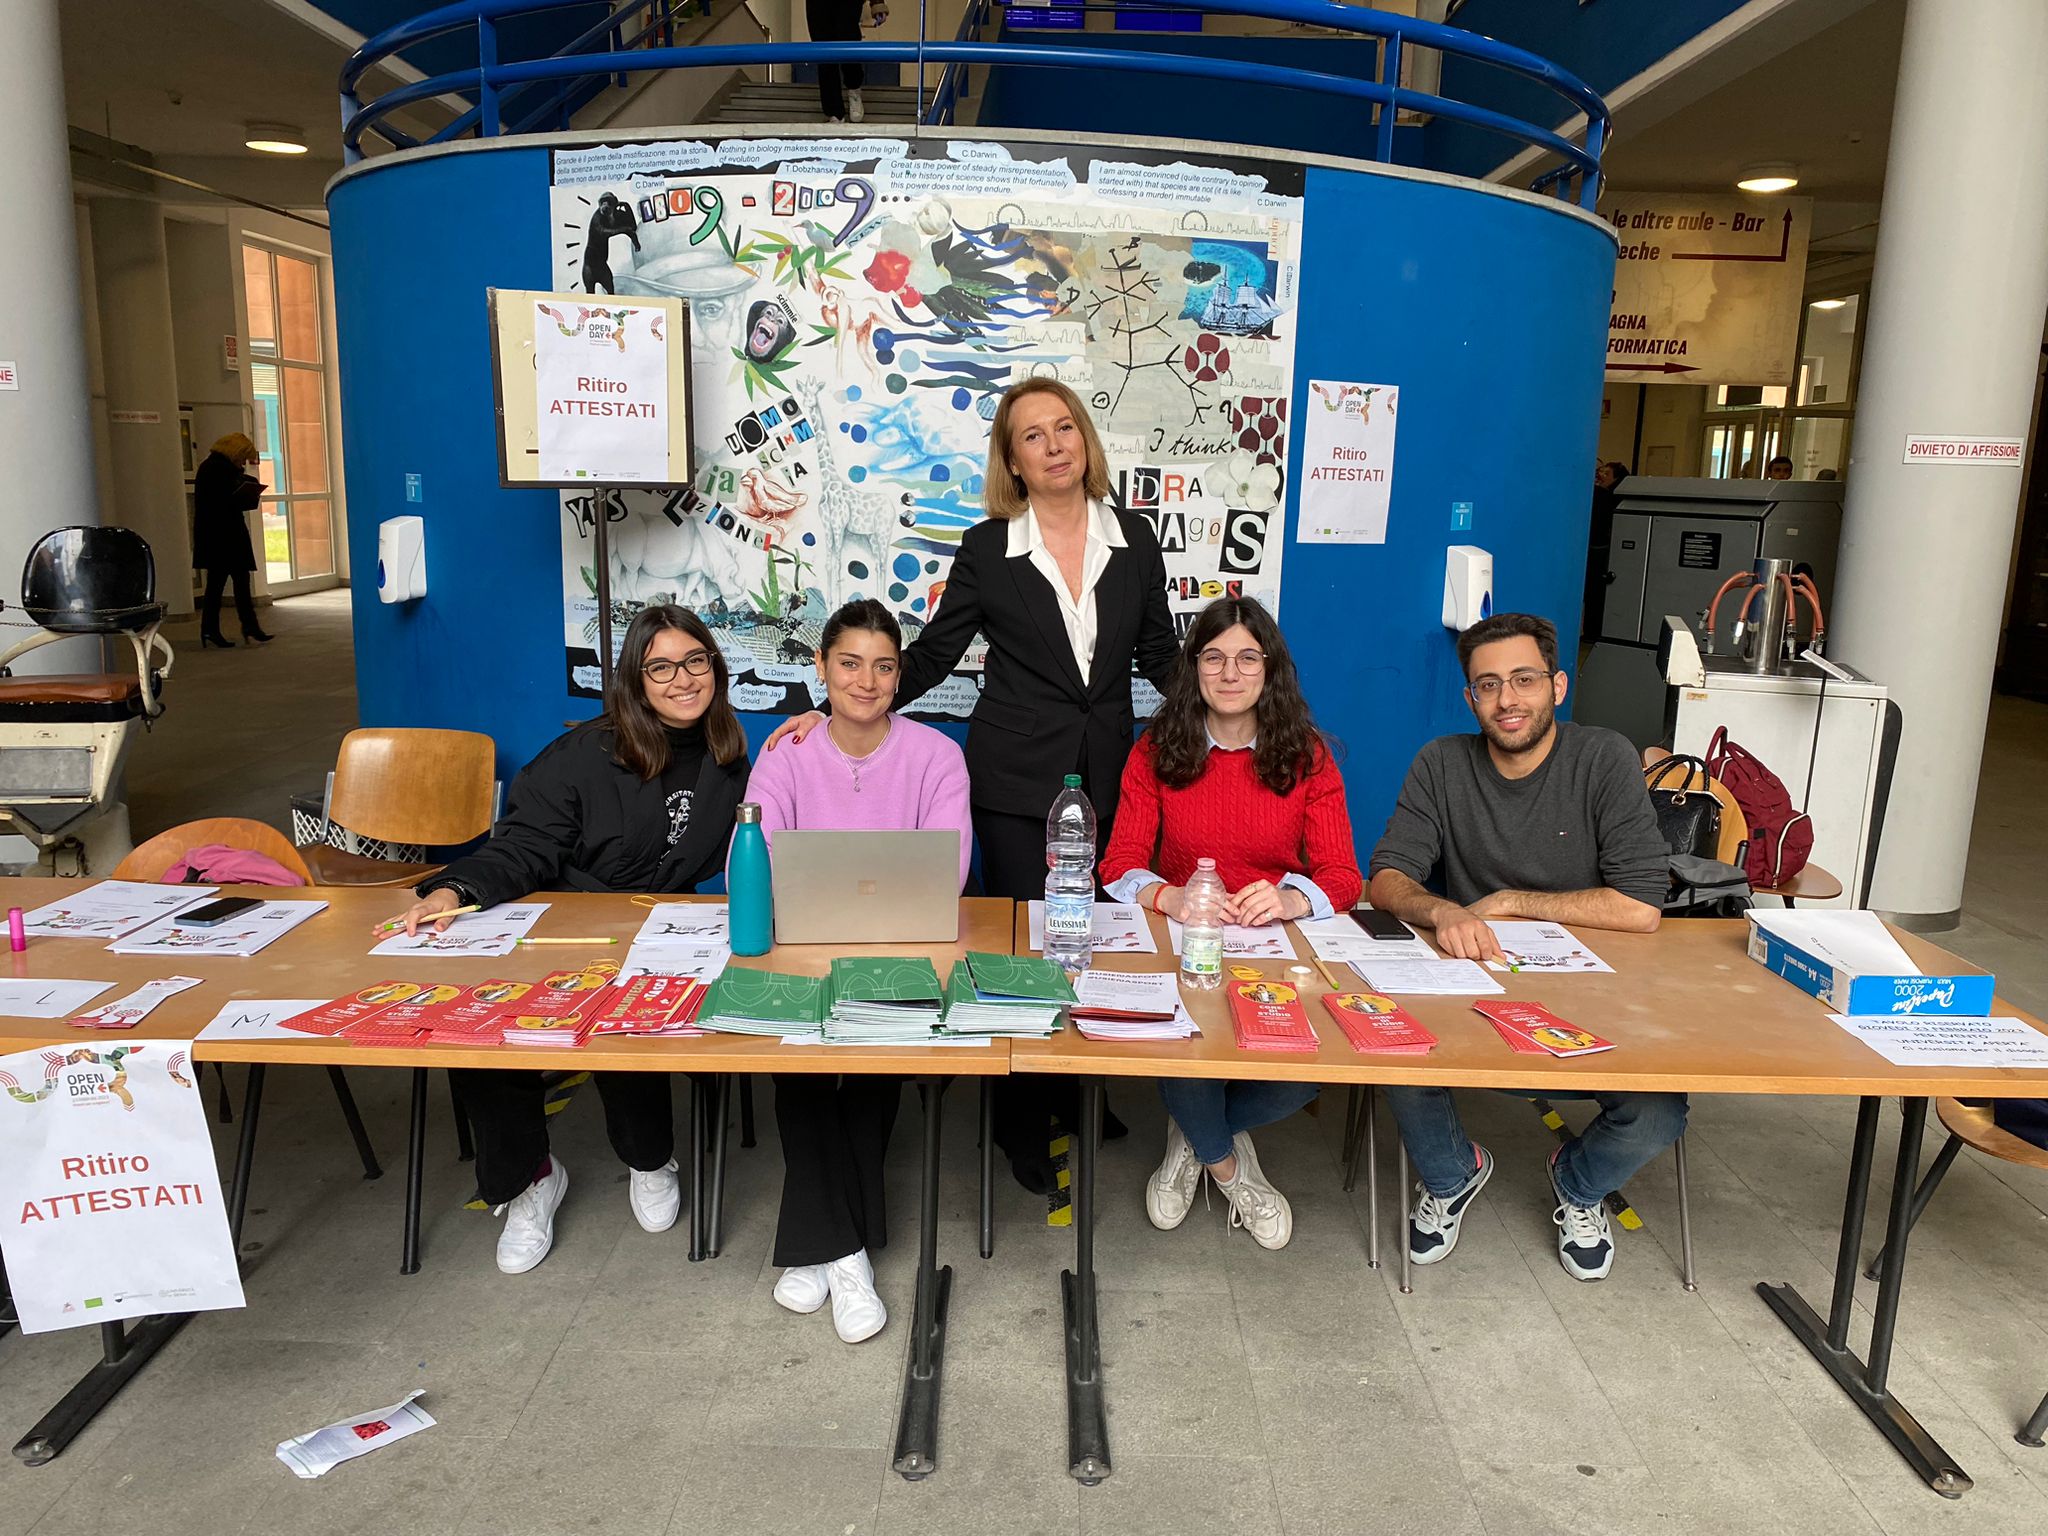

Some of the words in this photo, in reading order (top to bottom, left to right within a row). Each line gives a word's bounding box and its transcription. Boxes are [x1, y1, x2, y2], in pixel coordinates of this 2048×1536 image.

[556, 158, 576, 166] Grande
[587, 155, 606, 164] potere
[607, 153, 622, 161] della
[689, 147, 708, 155] storia
[718, 145, 747, 155] Nothing
[748, 145, 754, 153] in
[756, 145, 783, 154] biology
[784, 145, 809, 153] makes
[834, 145, 860, 155] except
[861, 145, 868, 153] in
[869, 145, 882, 154] the
[883, 145, 900, 156] light
[961, 149, 998, 160] C.Darwin
[556, 167, 570, 175] della
[571, 165, 593, 174] scienza
[594, 164, 614, 172] mostra
[615, 162, 627, 170] che
[628, 158, 676, 169] fortunatamente
[678, 158, 700, 167] questo
[728, 155, 760, 163] evolution
[890, 160, 913, 169] Great
[914, 161, 921, 169] is
[922, 162, 935, 170] the
[936, 163, 961, 173] power
[962, 163, 971, 171] of
[971, 164, 997, 174] steady
[998, 166, 1068, 178] misrepresentation,
[556, 177, 575, 185] potere
[576, 175, 587, 183] non
[588, 174, 601, 182] dura
[607, 173, 625, 182] lungo
[890, 171, 903, 179] but
[904, 171, 917, 179] the
[918, 172, 945, 182] history
[946, 172, 955, 181] of
[955, 174, 985, 183] science
[986, 175, 1011, 184] shows
[1012, 176, 1027, 185] that
[1028, 178, 1068, 189] fortunately
[1098, 177, 1125, 186] started
[1125, 178, 1144, 188] with)
[1144, 180, 1159, 189] that
[1160, 182, 1187, 193] species
[1201, 185, 1214, 194] not
[1230, 188, 1242, 196] like
[1117, 168, 1142, 178] almost
[1142, 170, 1180, 181] convinced
[1180, 172, 1201, 183] (quite
[1202, 176, 1230, 187] contrary
[1230, 178, 1238, 186] to
[1238, 180, 1263, 189] opinion
[890, 181, 904, 189] this
[905, 183, 930, 192] power
[931, 183, 951, 191] does
[951, 184, 965, 192] not
[965, 184, 983, 194] long
[983, 186, 1013, 194] endure.
[1098, 188, 1138, 198] confessing
[1145, 190, 1174, 201] murder)
[1175, 193, 1212, 203] immutable
[640, 186, 724, 246] 1809
[772, 179, 876, 248] 2009
[1612, 209, 1627, 225] le
[1631, 210, 1673, 230] altre
[1677, 211, 1714, 231] aule
[1731, 212, 1765, 232] Bar
[1618, 241, 1661, 260] eche
[776, 293, 798, 324] scimmie
[588, 323, 611, 332] OPEN
[1608, 314, 1647, 330] AGNA
[588, 331, 605, 339] DAY
[1607, 338, 1688, 355] FORMATICA
[577, 376, 628, 394] Ritiro
[549, 400, 657, 419] ATTESTATI
[1345, 400, 1362, 408] OPEN
[1168, 434, 1232, 457] think
[1910, 443, 1955, 456] DIVIETO
[1957, 444, 1970, 456] DI
[1970, 445, 2020, 458] AFFISSIONE
[1332, 446, 1368, 462] Ritiro
[1310, 466, 1385, 483] ATTESTATI
[580, 669, 591, 677] The
[740, 687, 768, 697] Stephen
[769, 689, 782, 698] Jay
[740, 696, 761, 705] Gould
[950, 692, 959, 702] gli
[1049, 918, 1087, 929] LEVISSIMA
[1808, 967, 1818, 982] A4
[1891, 983, 1955, 1013] Paperline
[1894, 984, 1924, 997] 2000
[67, 1073, 105, 1086] OPEN
[69, 1084, 95, 1096] DAY
[61, 1152, 150, 1180] Ritiro
[20, 1184, 204, 1225] ATTESTATI
